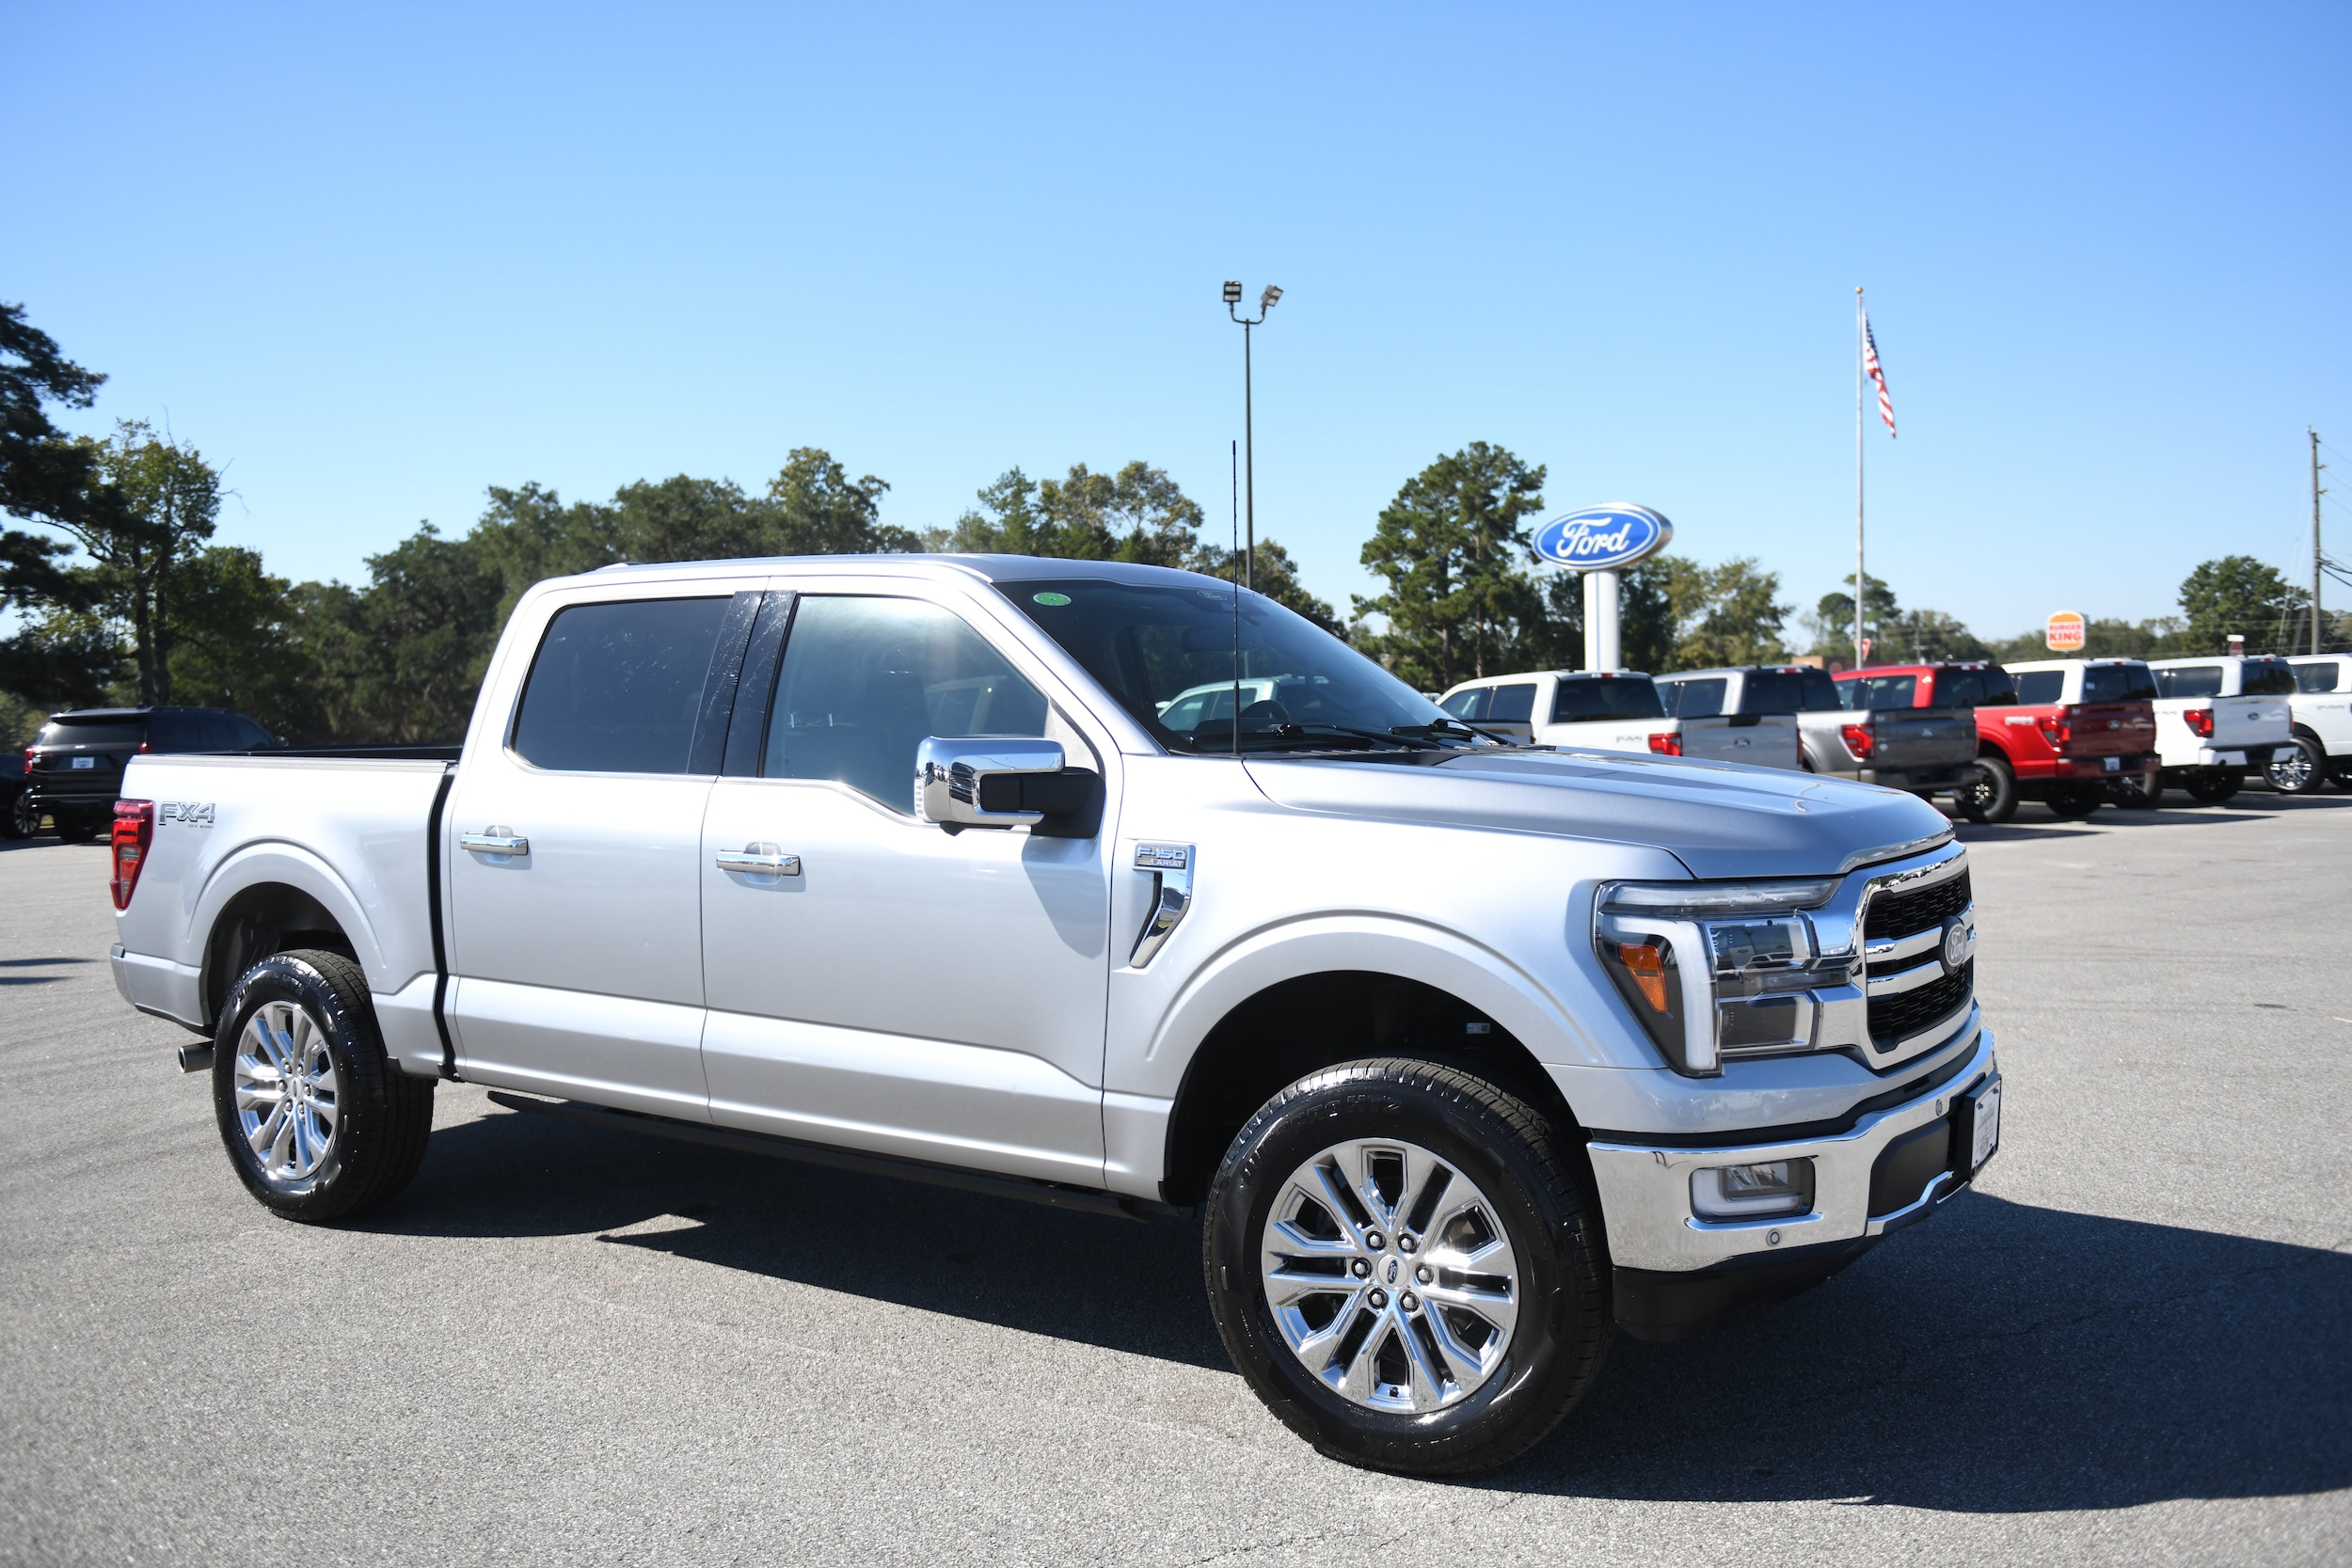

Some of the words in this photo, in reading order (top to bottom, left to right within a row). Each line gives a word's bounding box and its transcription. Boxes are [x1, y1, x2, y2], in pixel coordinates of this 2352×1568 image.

[1555, 516, 1632, 558] Ford
[2048, 631, 2082, 641] KING
[158, 800, 216, 826] FX4
[1136, 847, 1187, 861] F-150
[1150, 858, 1184, 867] LARIAT
[1950, 930, 1965, 960] Ford
